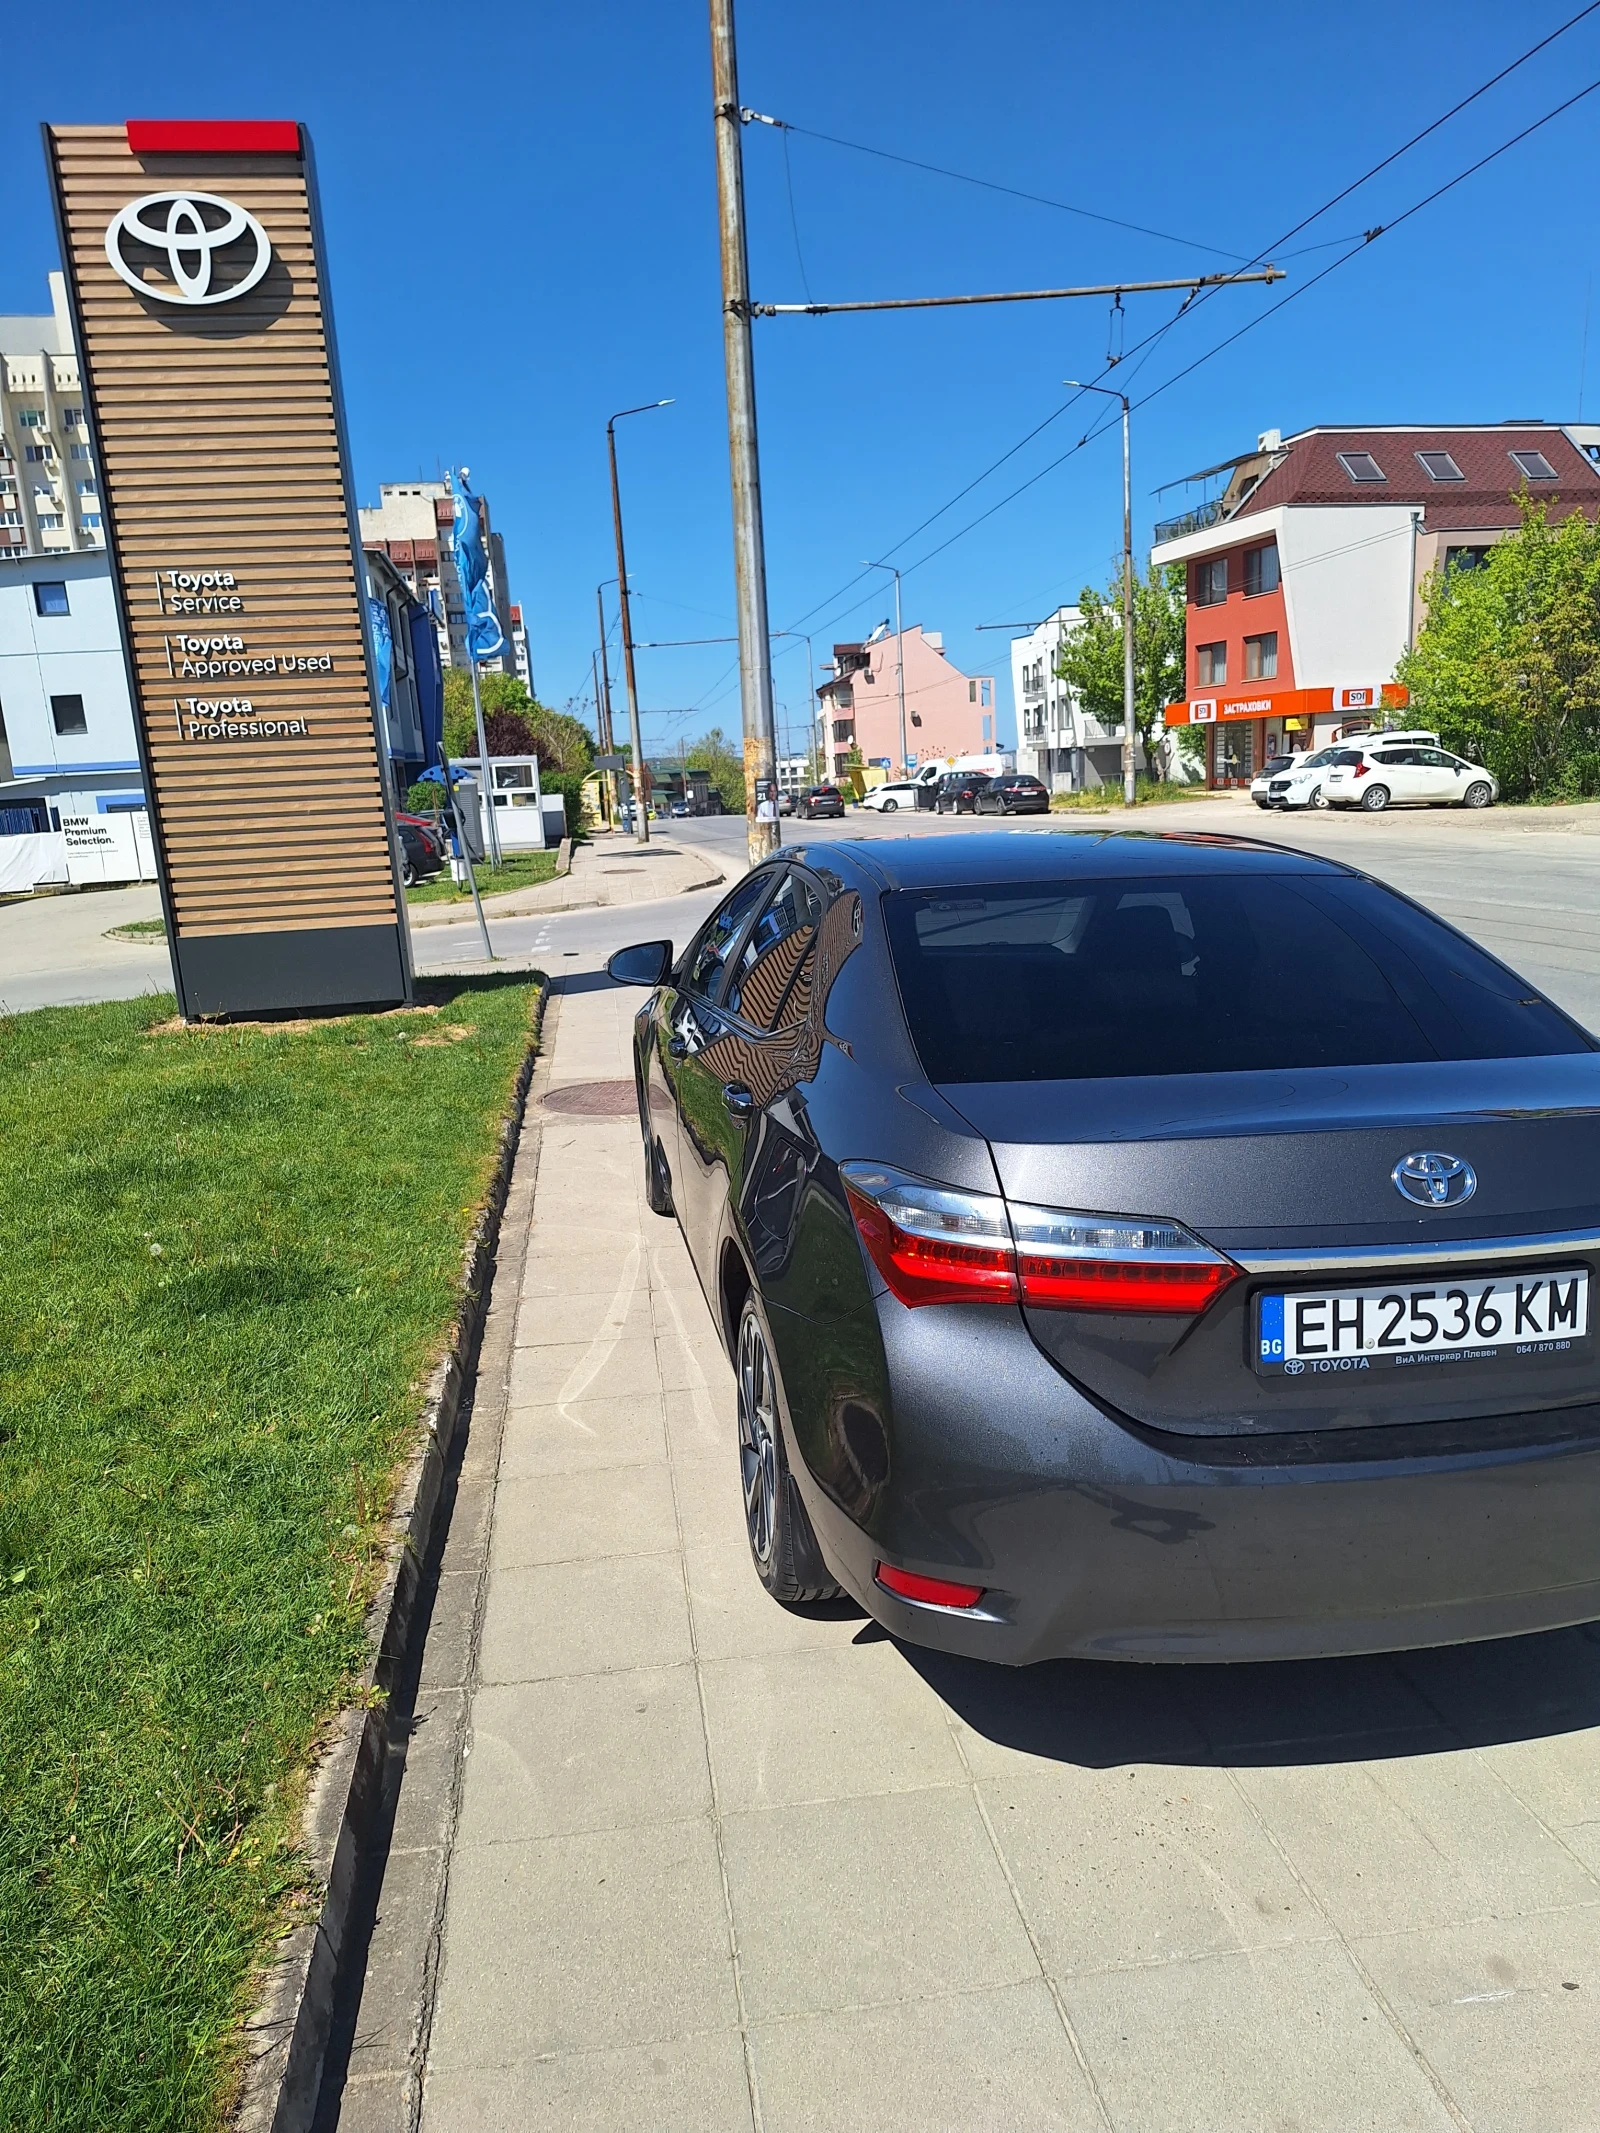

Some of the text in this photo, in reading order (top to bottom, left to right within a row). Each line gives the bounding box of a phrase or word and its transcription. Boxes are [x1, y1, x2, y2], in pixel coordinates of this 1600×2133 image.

[167, 570, 235, 591] Toyota
[171, 593, 241, 611] Service
[176, 634, 243, 655] Toyota
[181, 652, 331, 678] Approved Used
[1350, 691, 1365, 701] SDI
[186, 698, 252, 718] Toyota
[1223, 699, 1271, 715] ЗАСТРАХОВКИ
[189, 716, 307, 738] Professional
[757, 792, 766, 801] 21
[62, 817, 89, 827] BMW
[64, 827, 107, 837] Premium
[66, 836, 115, 846] Selection.
[1377, 1286, 1502, 1347] 2536
[1261, 1339, 1282, 1355] BG
[1538, 1342, 1554, 1352] 870
[1555, 1340, 1571, 1350] 880
[1310, 1357, 1370, 1373] TOYOTA
[1395, 1349, 1497, 1365] ВиА Интеркар Плевен
